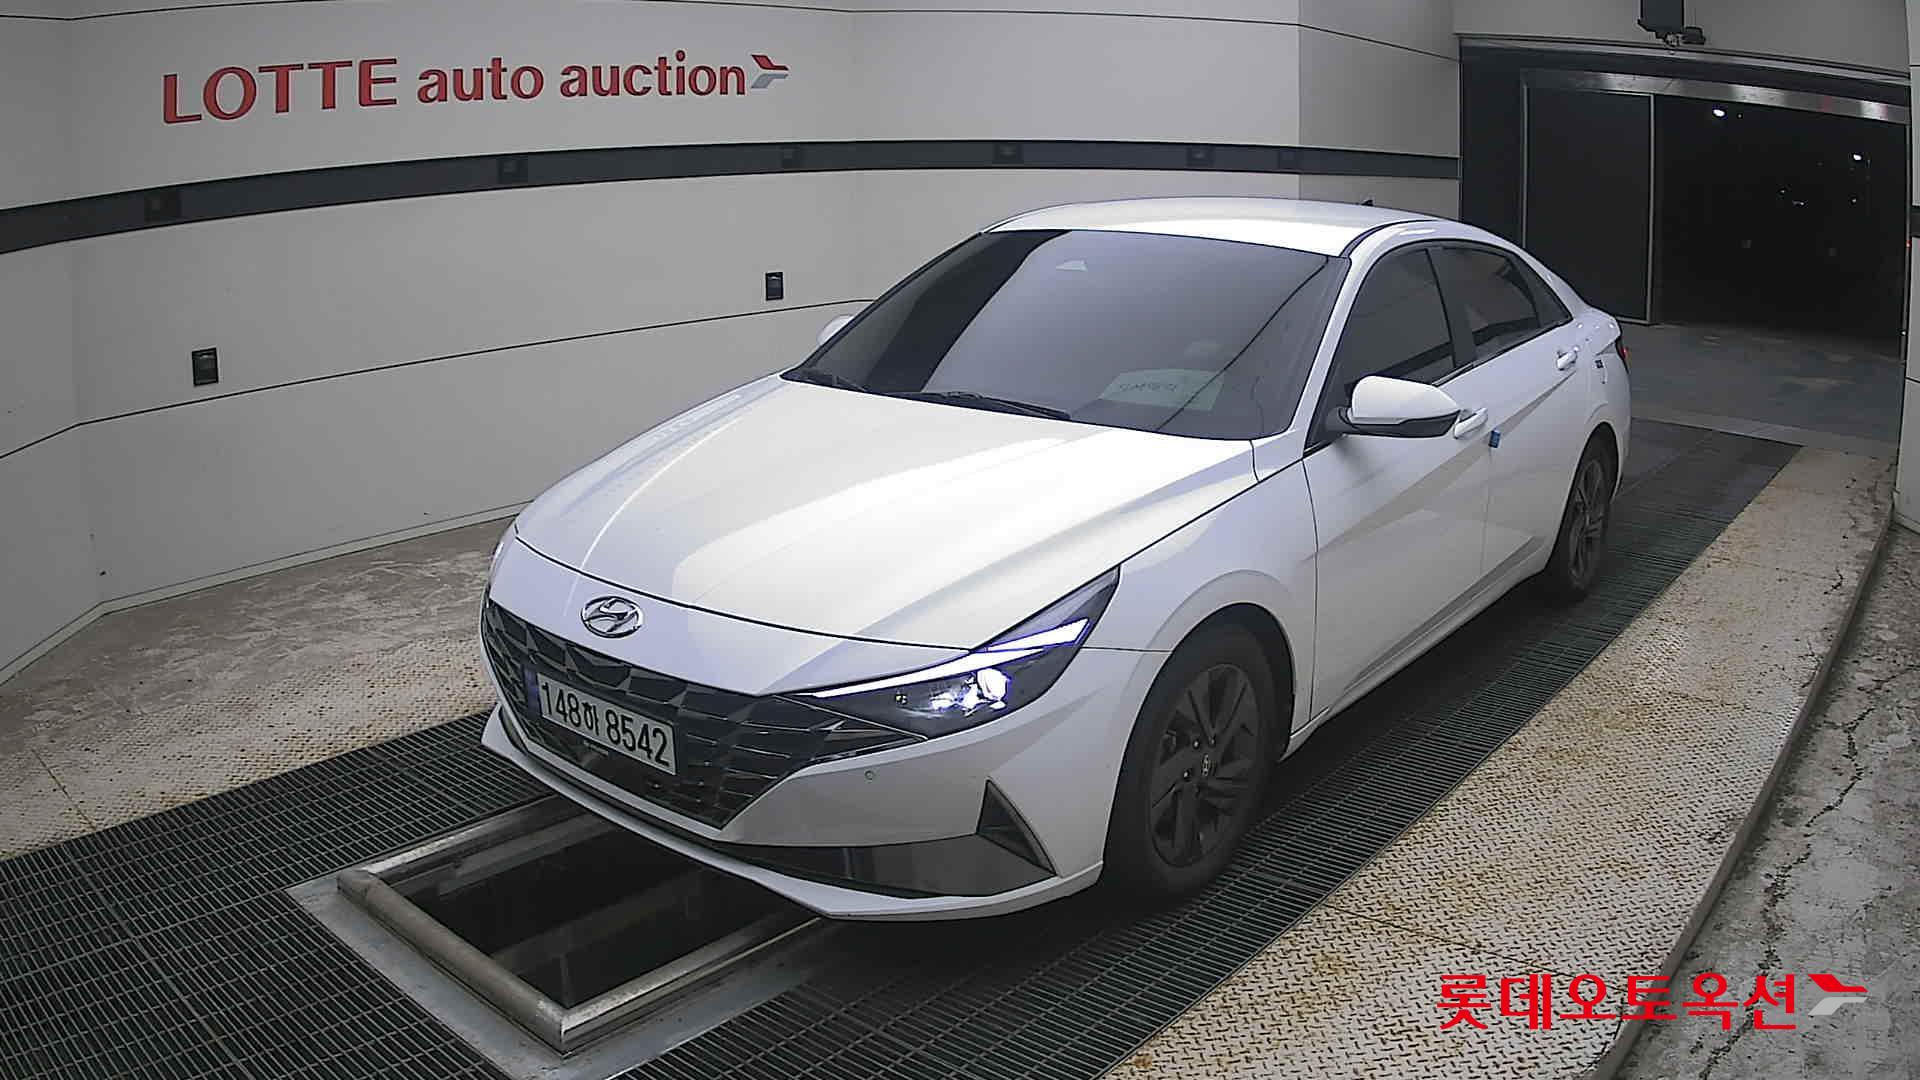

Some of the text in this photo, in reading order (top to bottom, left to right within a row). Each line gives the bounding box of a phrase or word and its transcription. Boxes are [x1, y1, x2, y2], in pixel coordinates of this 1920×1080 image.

[163, 50, 746, 124] LOTTE auto auction
[605, 709, 670, 767] 8542
